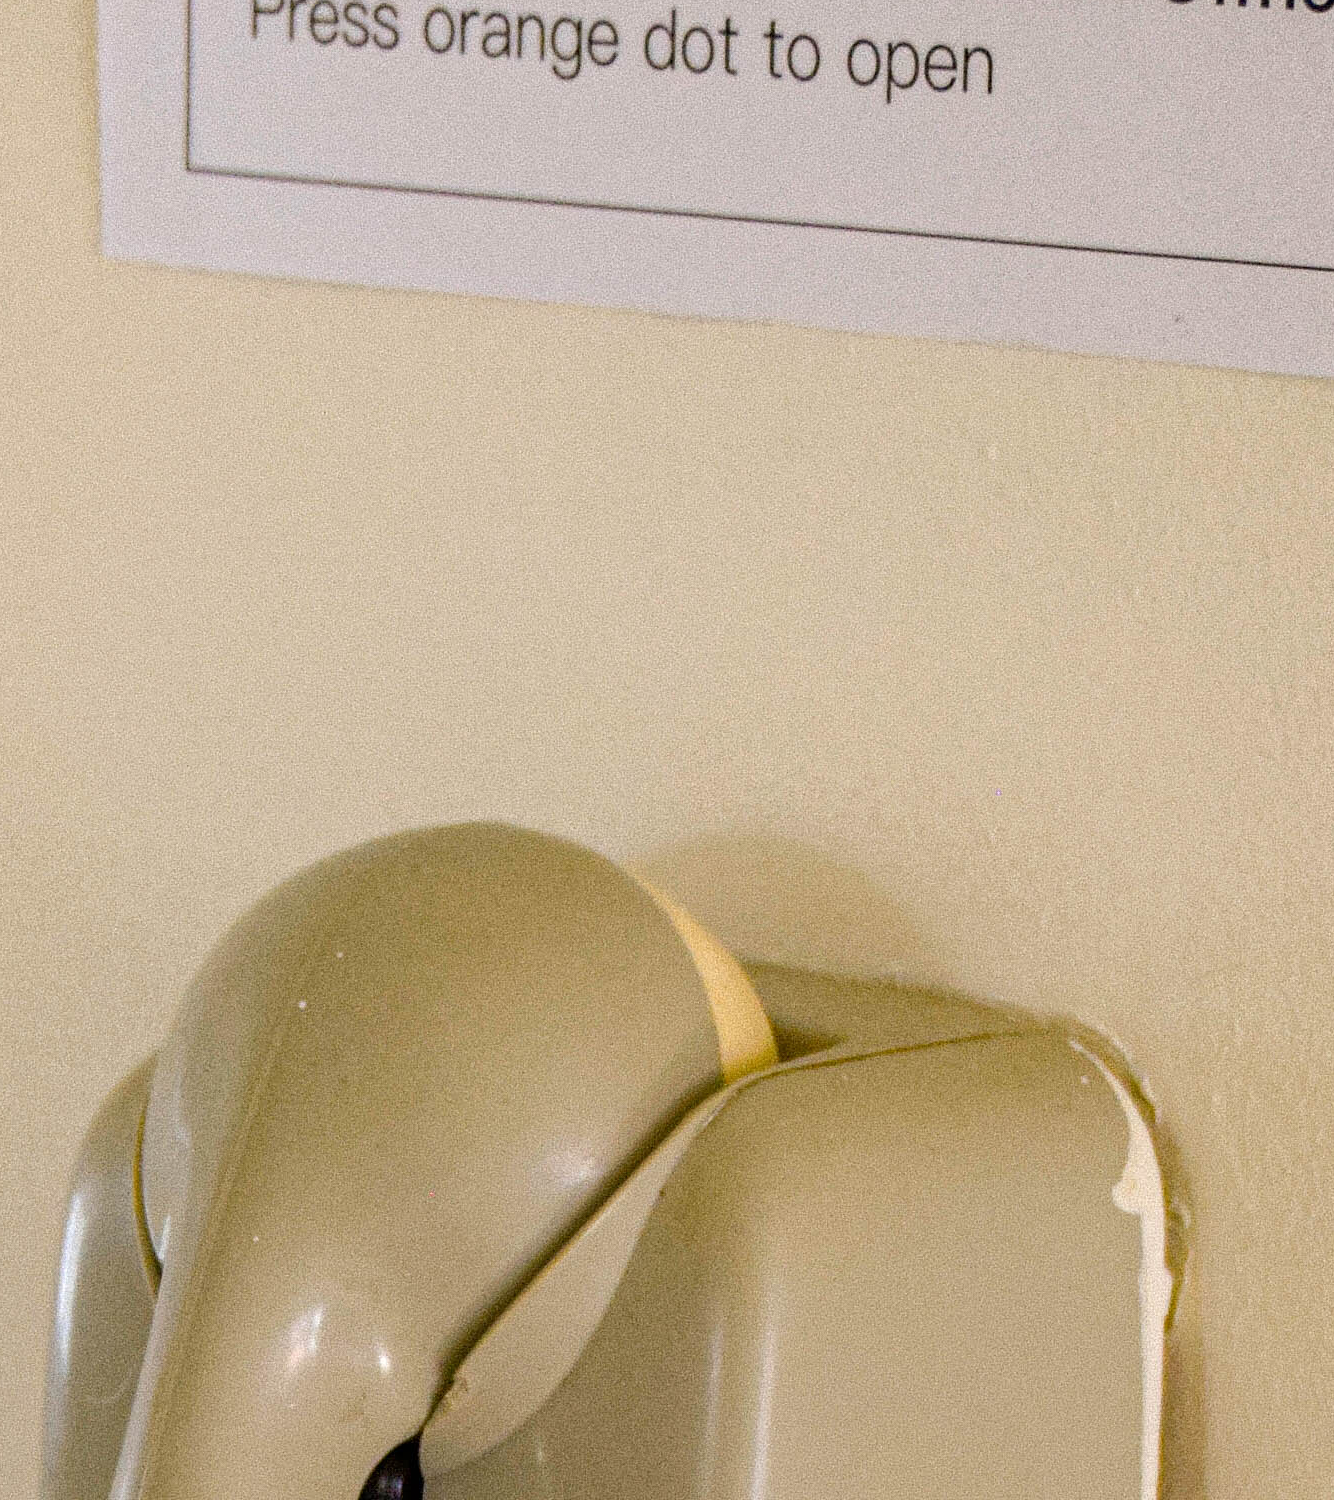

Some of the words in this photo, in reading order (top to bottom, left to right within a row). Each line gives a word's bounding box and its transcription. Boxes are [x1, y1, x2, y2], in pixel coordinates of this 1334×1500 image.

[423, 7, 620, 81] orange
[643, 8, 739, 76] dot
[763, 20, 822, 83] to
[846, 37, 995, 106] open
